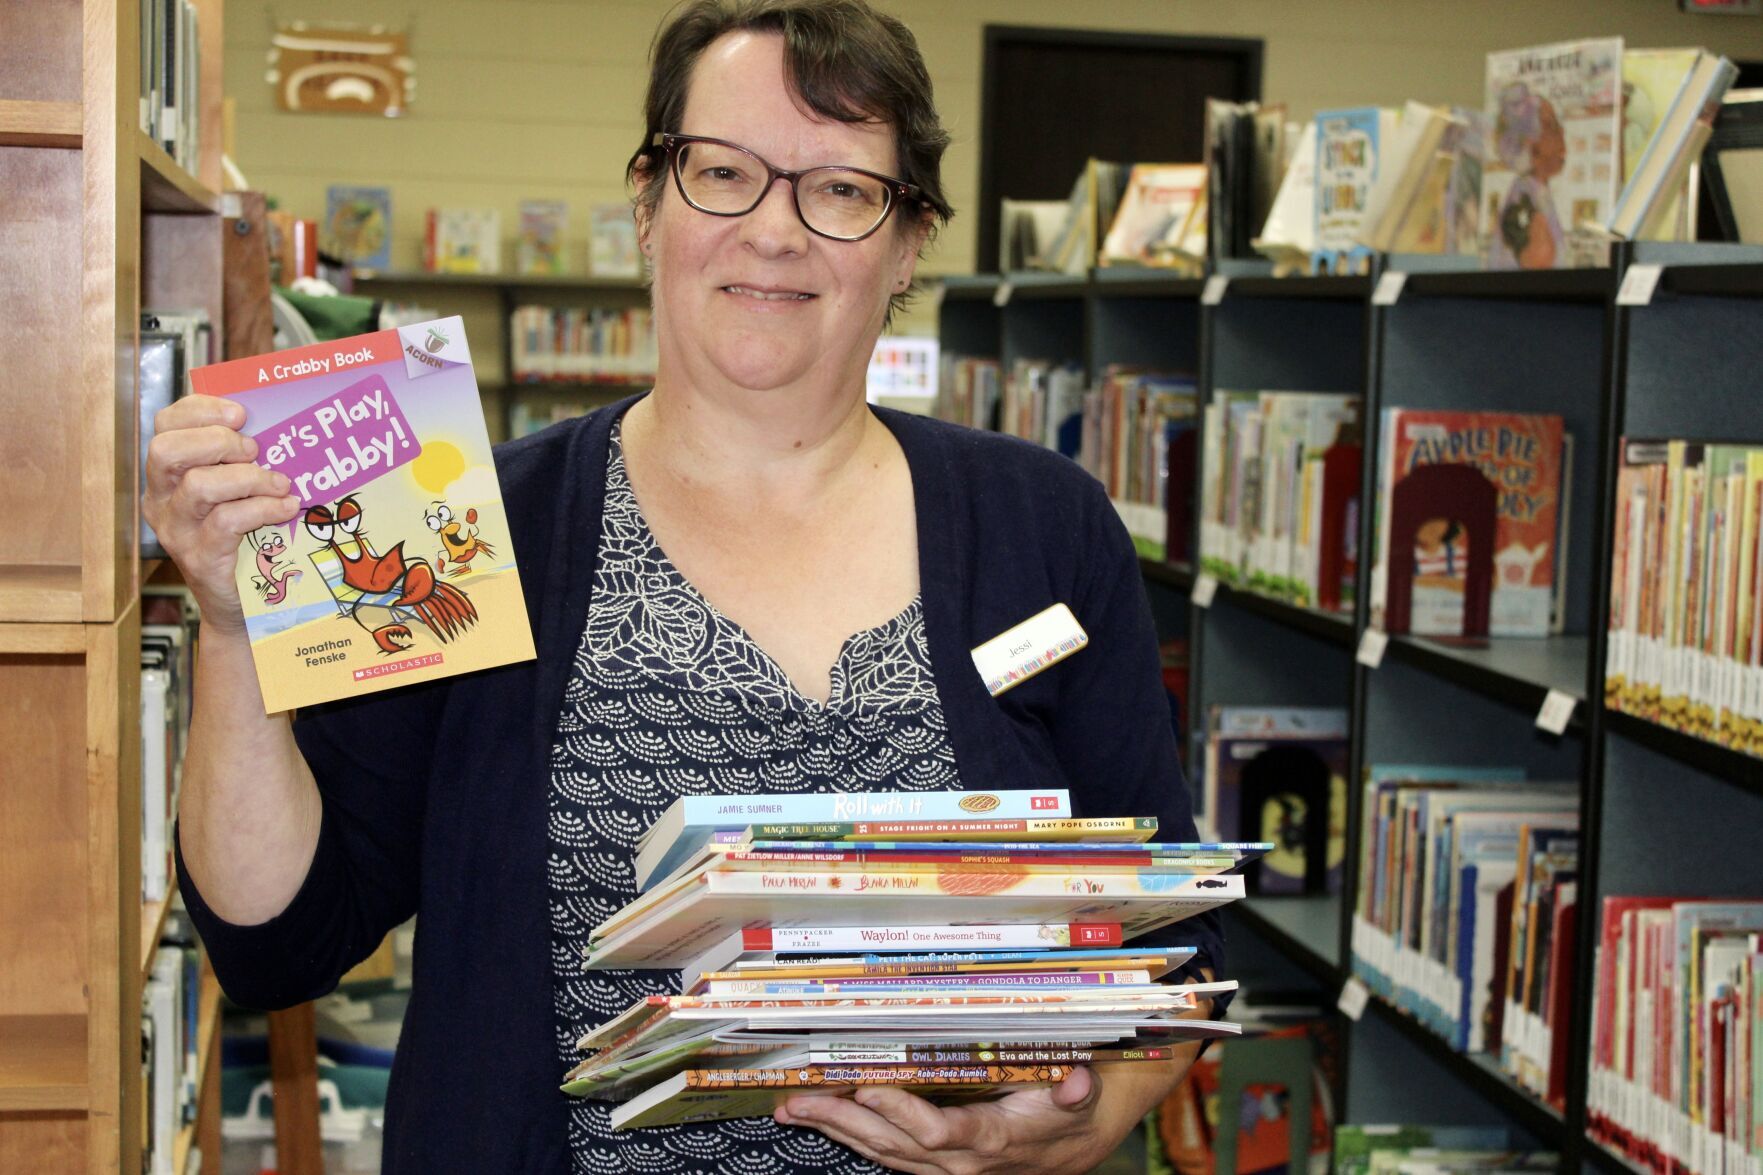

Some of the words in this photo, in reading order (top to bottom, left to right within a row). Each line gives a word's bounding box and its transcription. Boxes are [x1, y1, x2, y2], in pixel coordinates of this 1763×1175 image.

[258, 368, 270, 383] A
[273, 357, 330, 379] Crabby
[334, 347, 375, 367] Book
[405, 345, 443, 369] ACORN
[314, 389, 390, 439] Play,
[292, 416, 410, 502] rabby!
[295, 638, 352, 657] Jonathan
[1009, 639, 1033, 658] Jessi
[305, 652, 347, 667] Fenske
[365, 654, 442, 677] SCHOLASTIC
[718, 805, 744, 814] JAMIE
[747, 804, 783, 814] SUMNER
[833, 793, 869, 820] Roll
[871, 795, 904, 815] with
[909, 798, 923, 815] It
[763, 825, 790, 835] MAGIC
[791, 825, 810, 834] TREE
[747, 852, 772, 860] ZIETLOW
[961, 855, 987, 863] SOPHIE'S
[987, 855, 1011, 864] SQUASH
[861, 929, 909, 943] Waylon!
[913, 933, 931, 941] One
[933, 932, 974, 940] Awesome
[976, 931, 1002, 941] Thing
[900, 954, 916, 962] THE
[938, 953, 962, 961] SUPER
[964, 952, 984, 960] PETE
[978, 976, 1025, 985] GONDOLA
[1028, 976, 1041, 984] TO
[1043, 976, 1082, 984] DANGER
[912, 1052, 932, 1061] OWL
[935, 1051, 970, 1061] DIARIES
[1000, 1052, 1015, 1060] Eva
[1018, 1051, 1034, 1060] and
[1036, 1051, 1049, 1060] the
[1052, 1051, 1070, 1060] Lost
[1073, 1051, 1092, 1061] Pony
[706, 1073, 749, 1081] ANGLEBERGER
[754, 1073, 785, 1081] CHAPMAN
[825, 1070, 841, 1079] Didi
[842, 1070, 862, 1079] Dodo
[863, 1071, 895, 1079] FUTURE
[897, 1071, 914, 1079] SPY
[959, 1068, 987, 1078] Rumble
